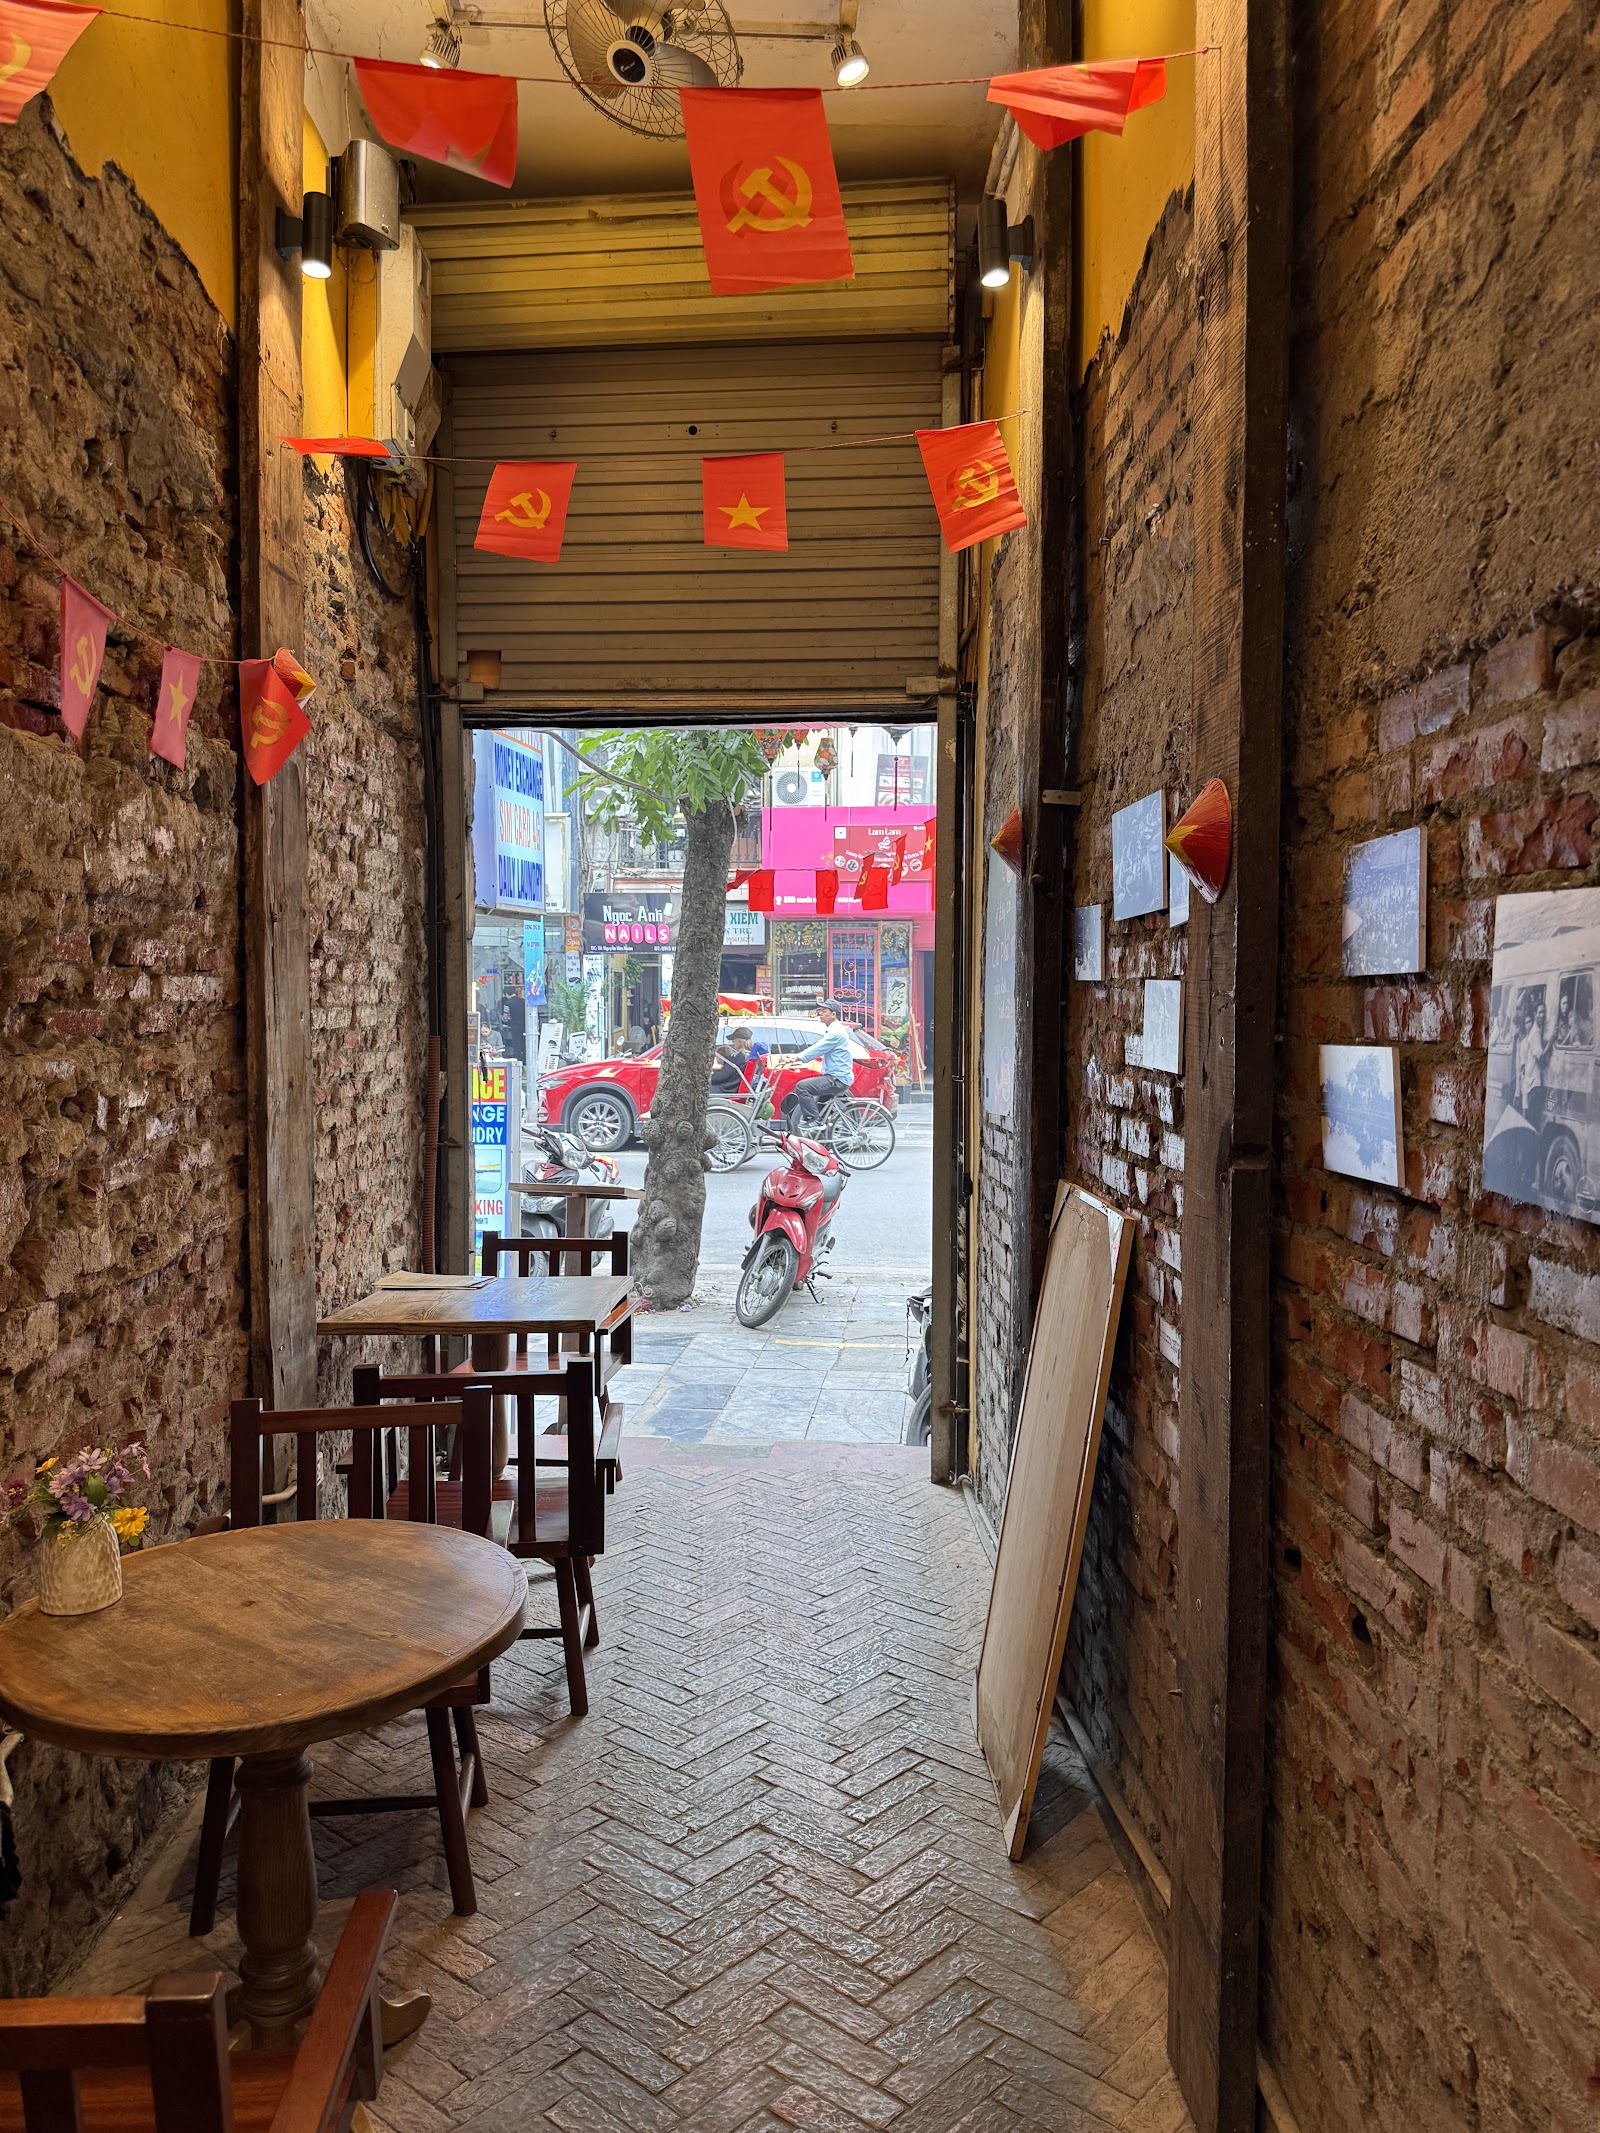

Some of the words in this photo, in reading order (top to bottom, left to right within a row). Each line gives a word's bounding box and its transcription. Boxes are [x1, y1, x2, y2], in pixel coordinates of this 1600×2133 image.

[494, 742, 515, 791] MONEY
[515, 751, 543, 802] EXCHANGE
[499, 799, 512, 843] SIM
[514, 803, 531, 848] CARD
[498, 854, 515, 898] DAILY
[517, 859, 543, 902] LAUNDRY
[602, 905, 633, 926] Ngọc
[730, 909, 758, 925] XIÊM
[604, 928, 669, 941] NAILS
